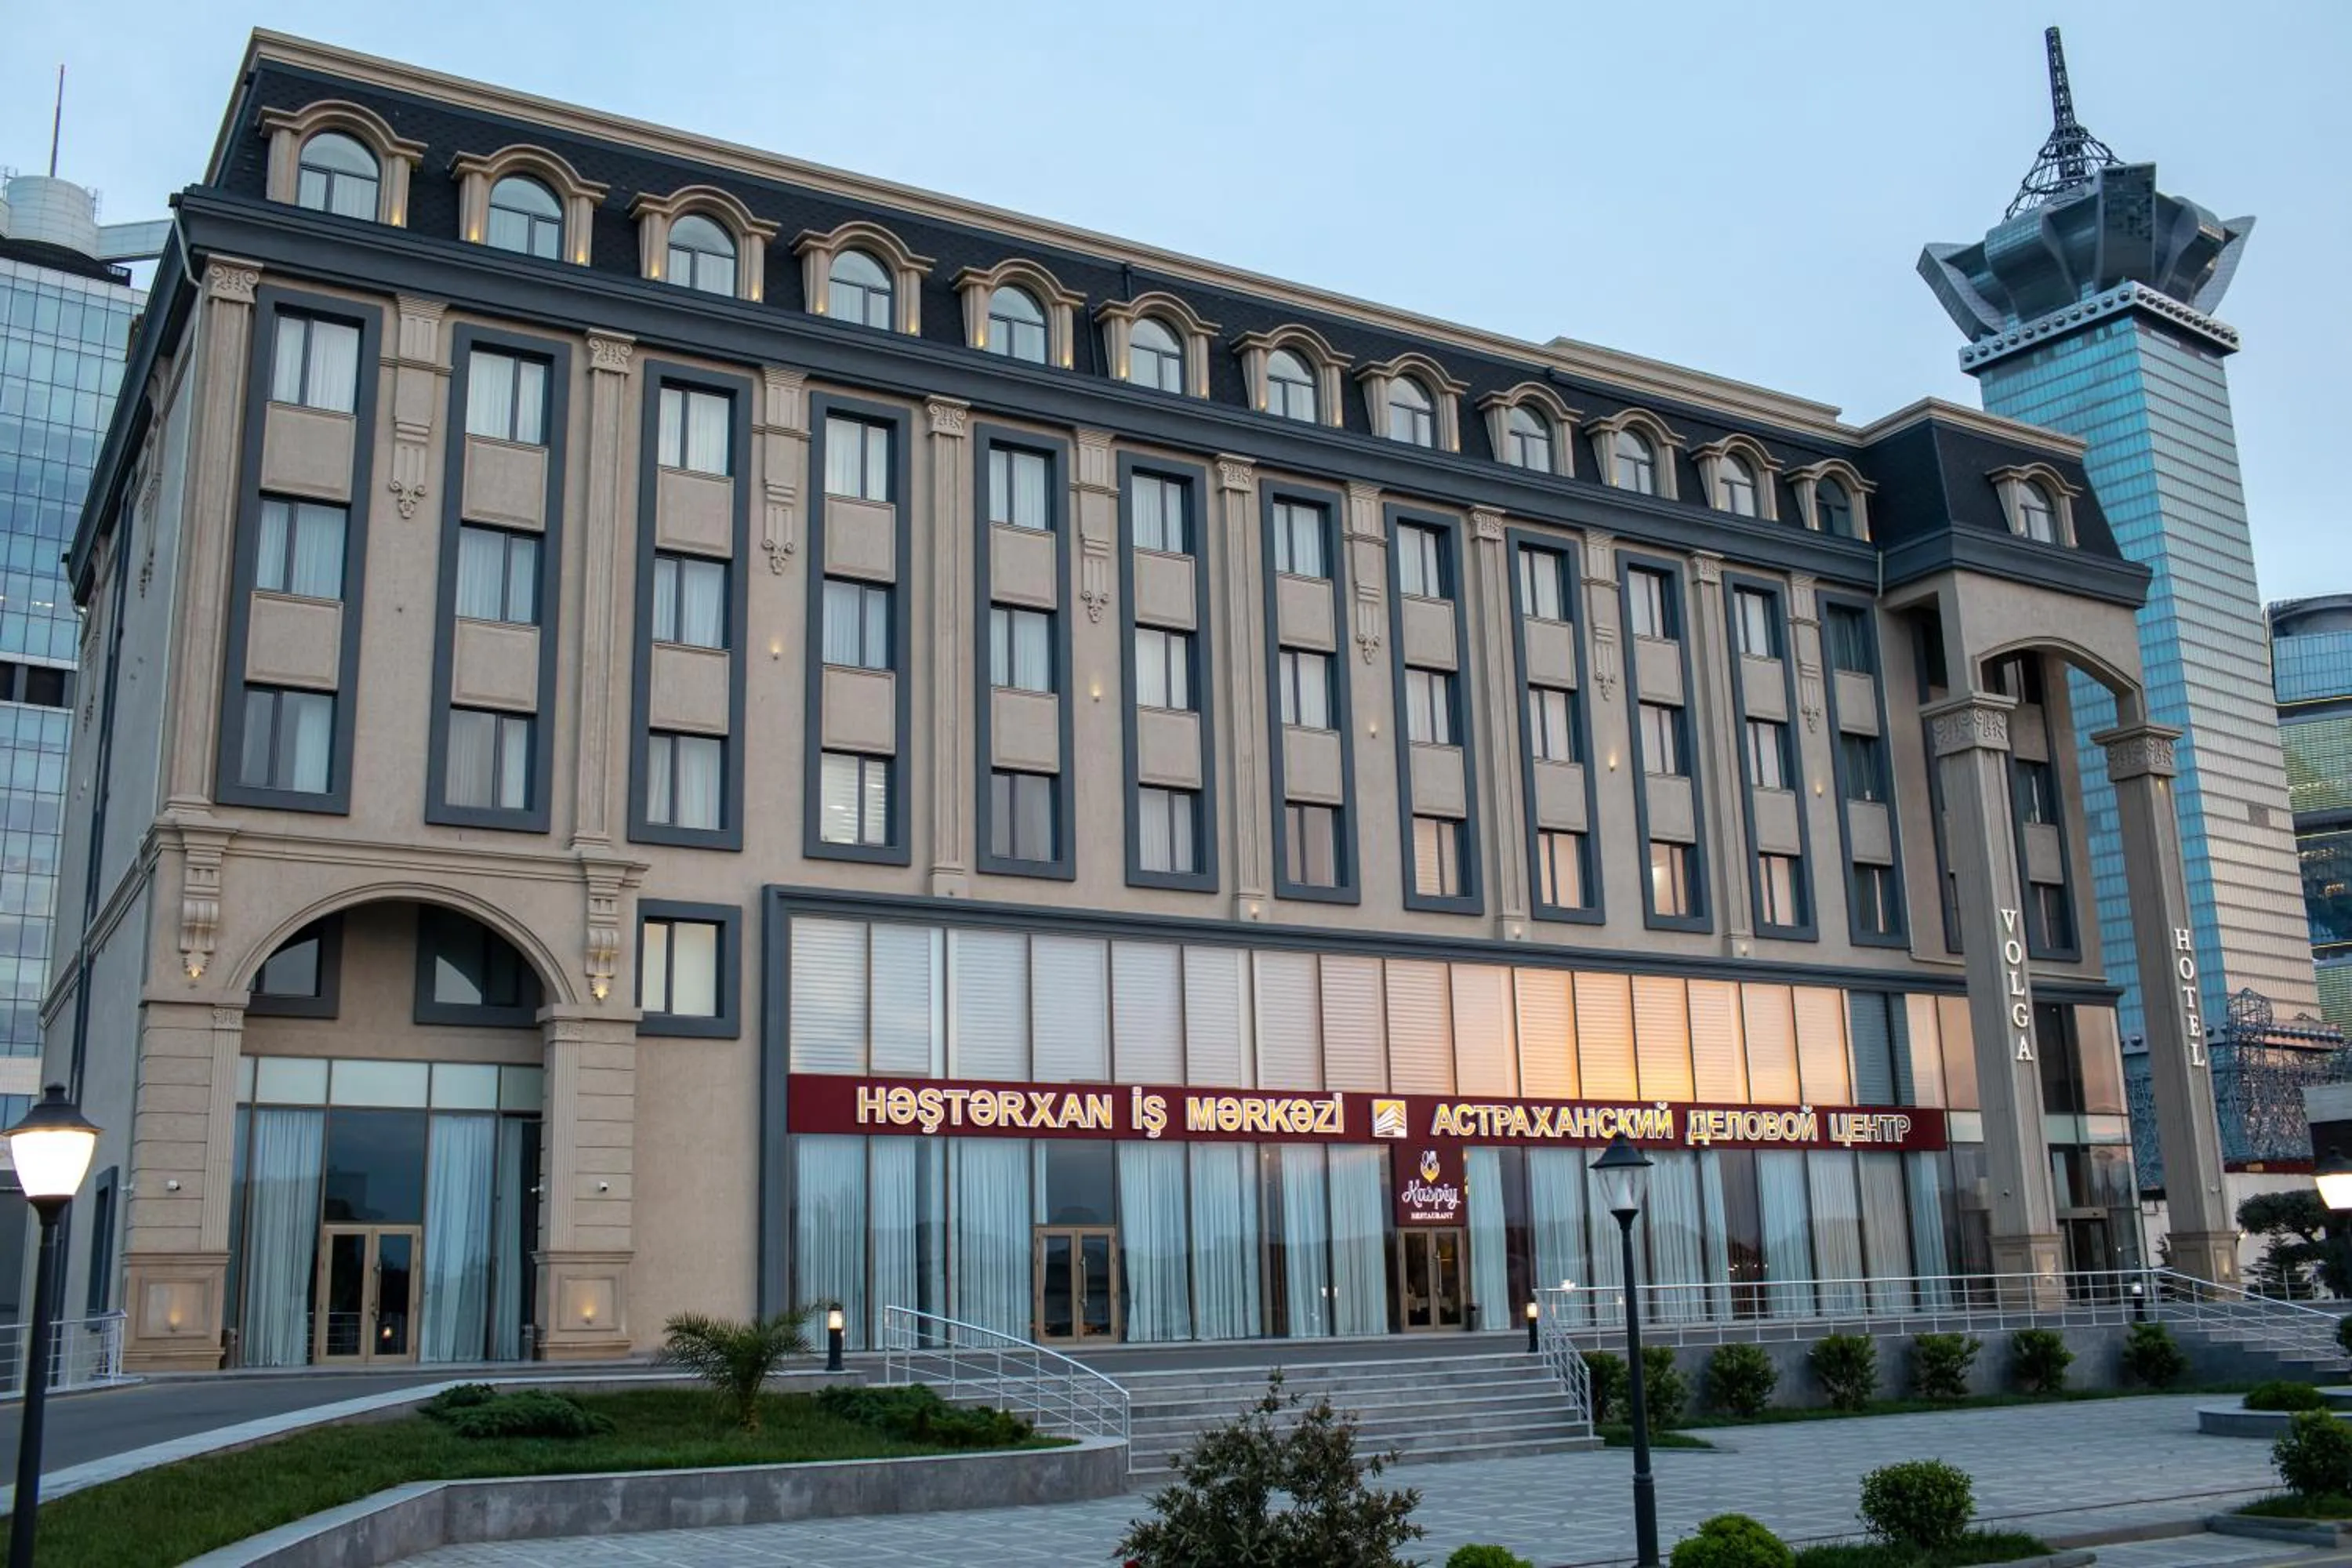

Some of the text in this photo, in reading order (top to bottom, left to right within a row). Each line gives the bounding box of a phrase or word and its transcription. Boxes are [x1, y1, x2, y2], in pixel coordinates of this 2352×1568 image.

[2001, 909, 2034, 1061] VOLGA
[2175, 928, 2205, 1067] HOTEL
[857, 1086, 1345, 1138] HƏŞTƏRXAN İŞ MƏRKƏZİ
[1431, 1101, 1911, 1147] АСТРАХАНСКИЙ ДЕЛОВОЙ ЦЕНТР
